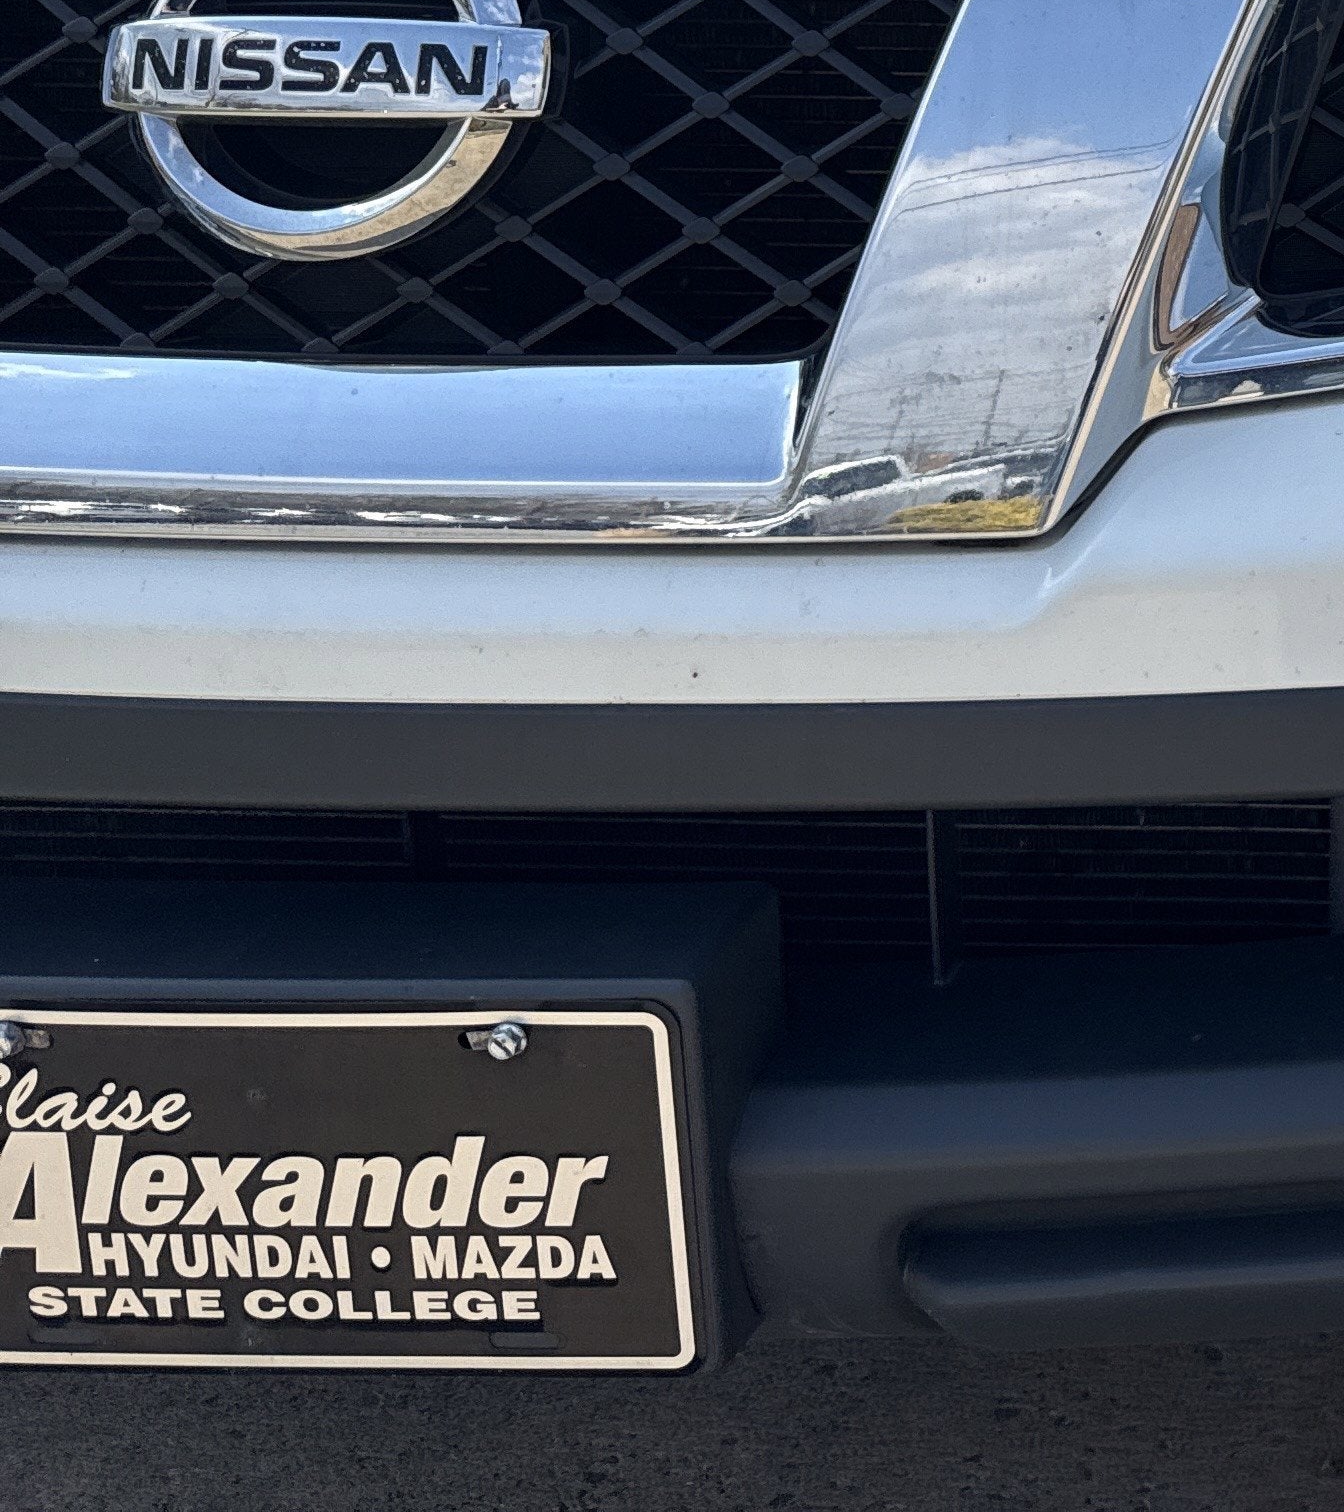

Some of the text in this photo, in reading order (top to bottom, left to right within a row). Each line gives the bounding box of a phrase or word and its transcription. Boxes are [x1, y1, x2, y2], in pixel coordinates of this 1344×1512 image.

[131, 38, 487, 96] NISSAN
[0, 1061, 192, 1131] laise
[0, 1131, 609, 1275] Alexander
[89, 1234, 617, 1280] HYUNDAI MAZDA
[28, 1286, 541, 1321] STATE COLLEGE
